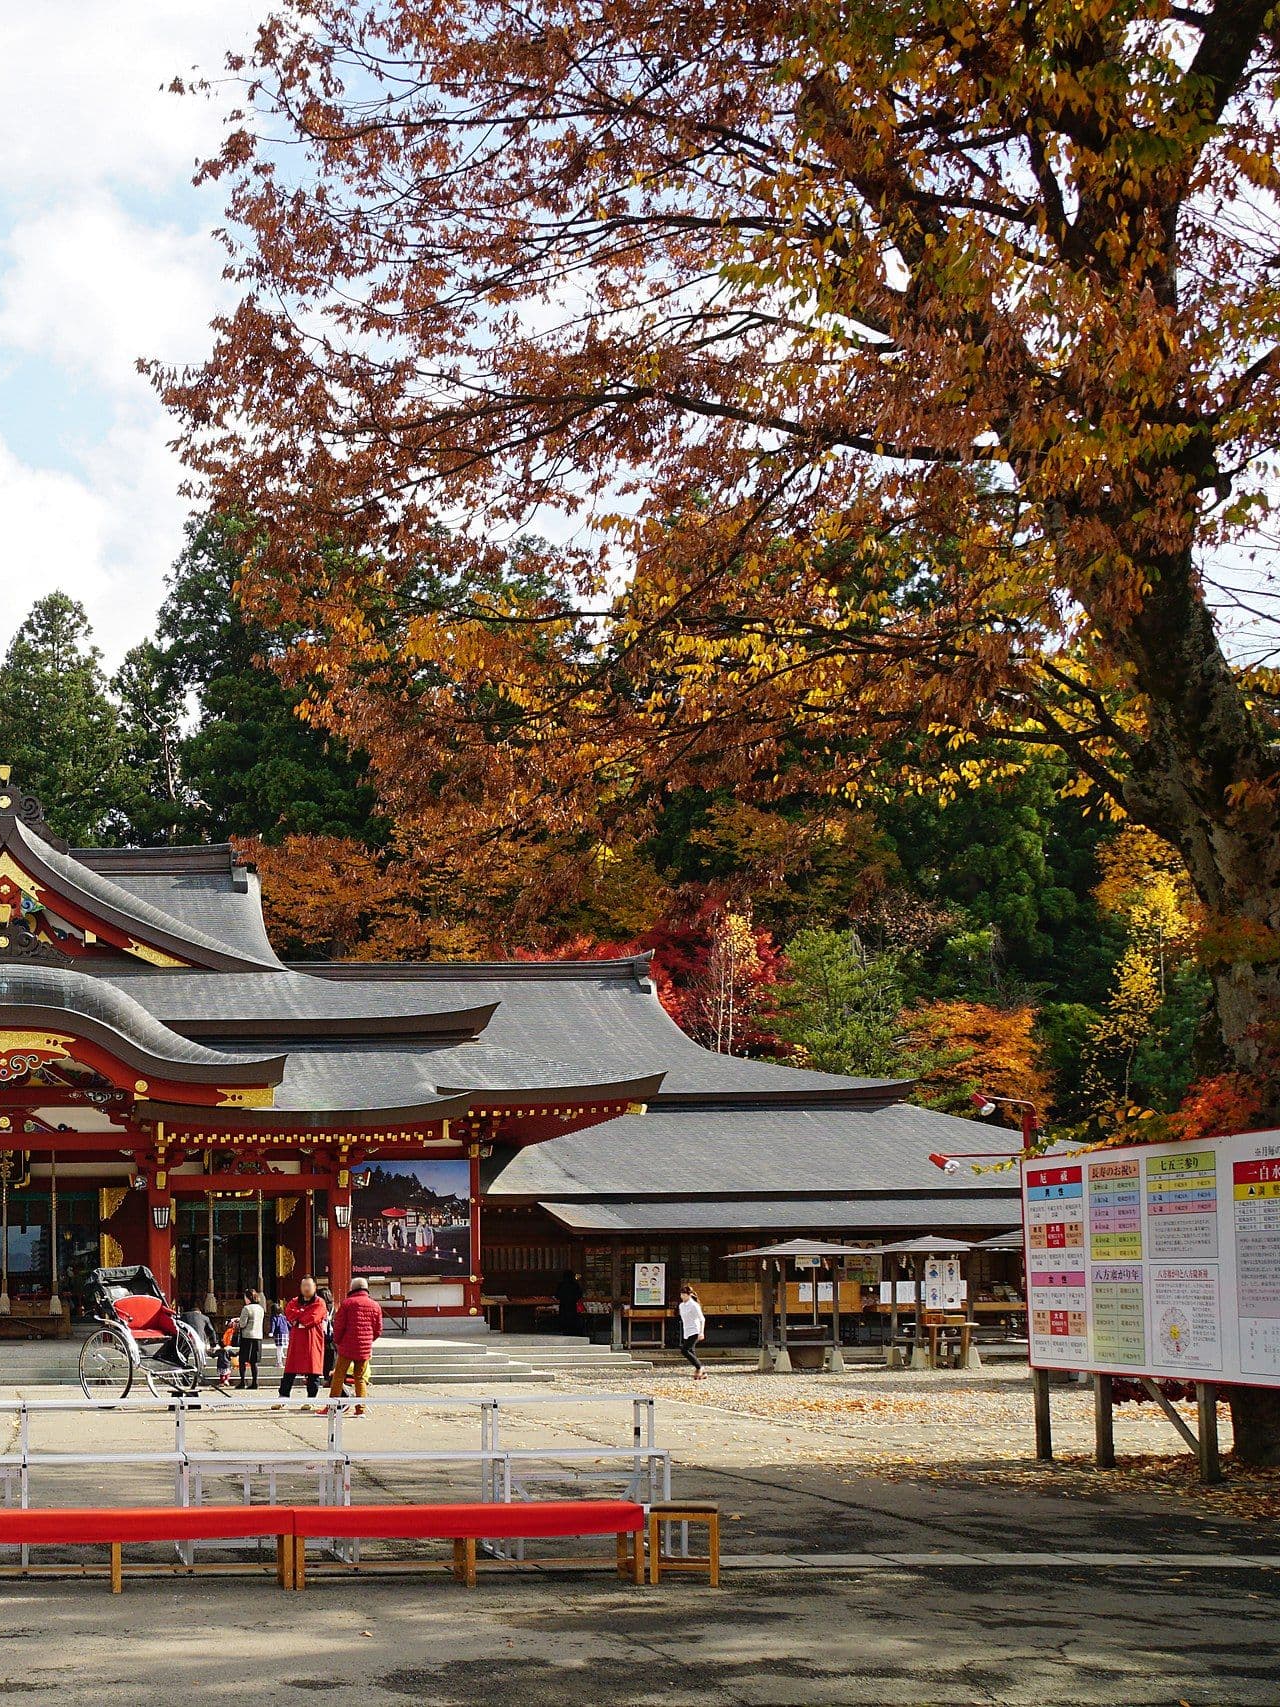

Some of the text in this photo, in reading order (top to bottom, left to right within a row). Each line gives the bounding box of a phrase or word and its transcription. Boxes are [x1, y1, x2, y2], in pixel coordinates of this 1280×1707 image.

[1160, 1157, 1199, 1171] 七五三参り
[1091, 1166, 1136, 1178] 長寿のお祝い
[1095, 1269, 1140, 1280] 八方塞がり年
